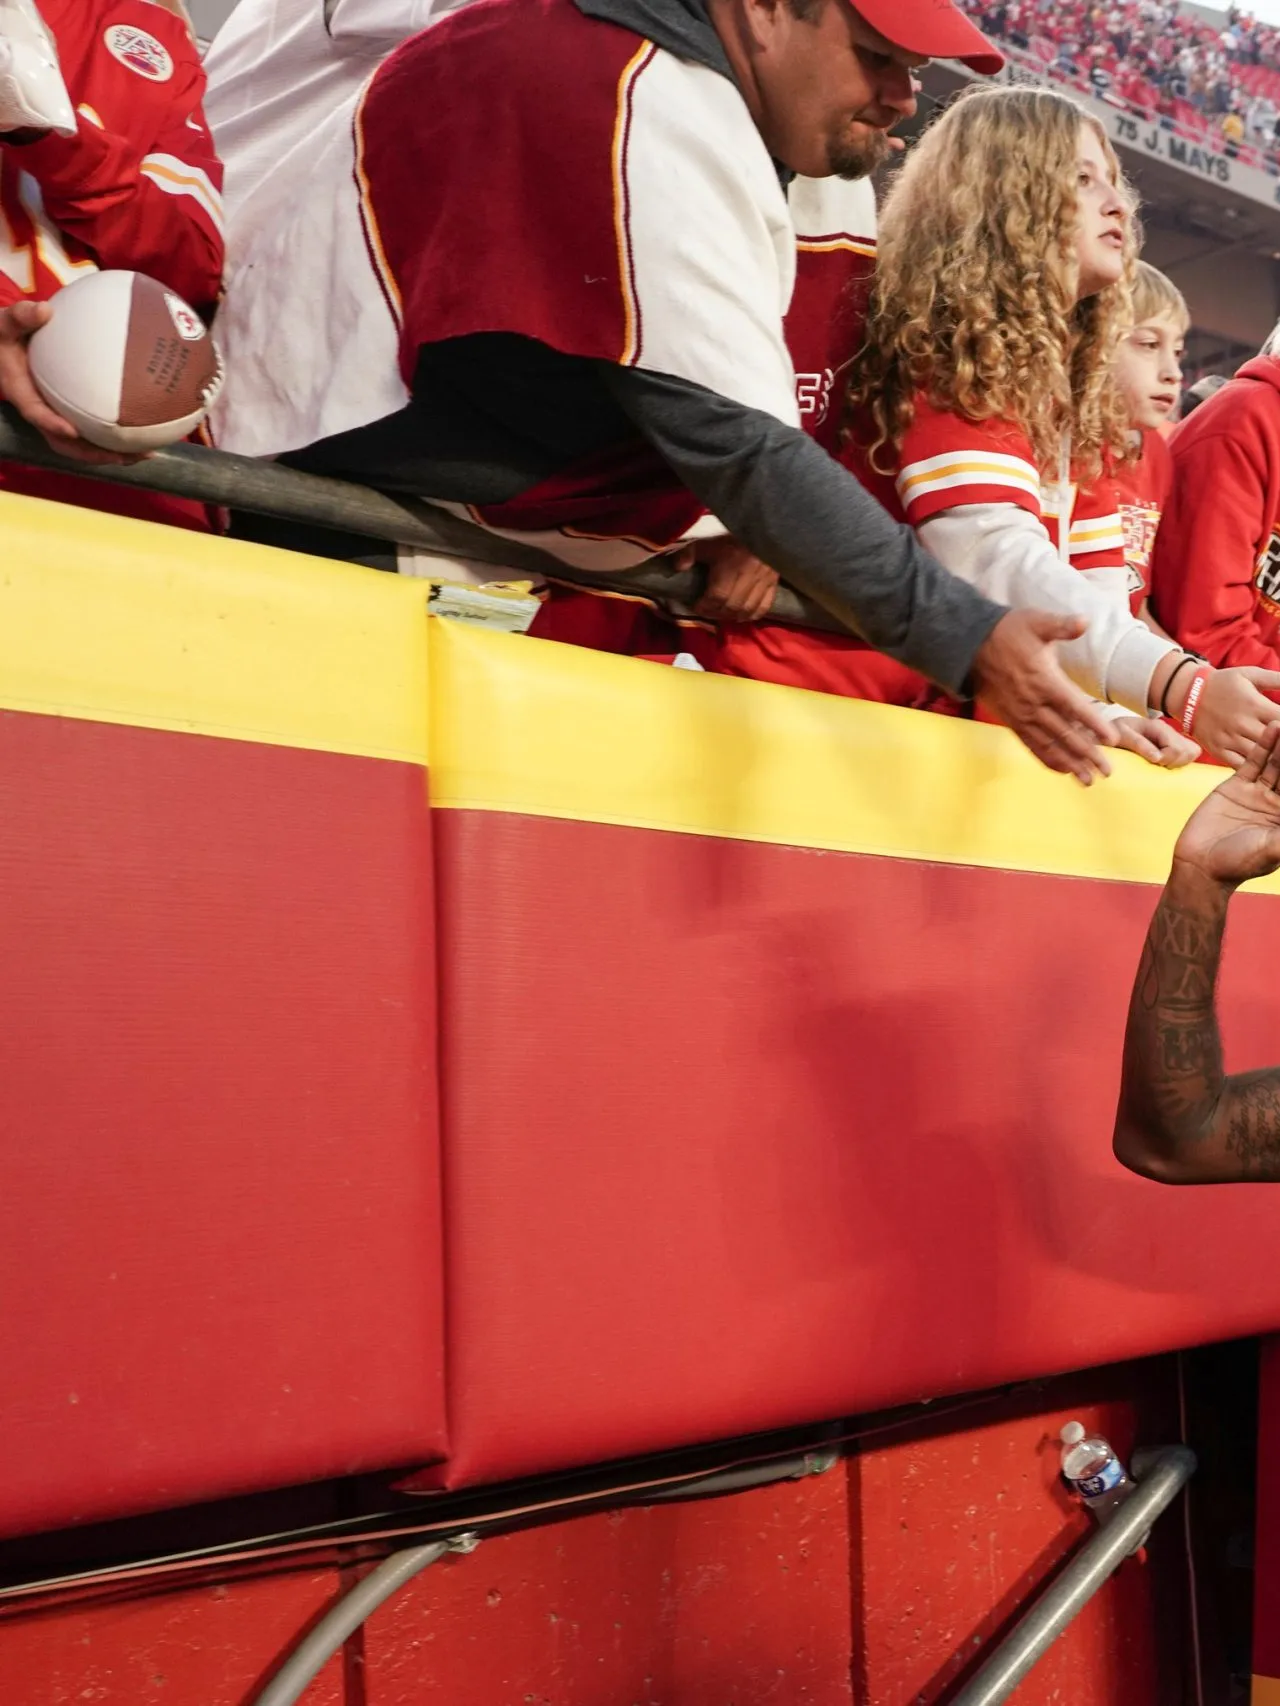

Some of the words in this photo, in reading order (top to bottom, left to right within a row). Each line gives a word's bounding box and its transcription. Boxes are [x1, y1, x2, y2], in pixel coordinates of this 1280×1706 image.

[1114, 115, 1138, 141] 75
[1145, 132, 1163, 154] J.
[1167, 137, 1231, 182] MAYS
